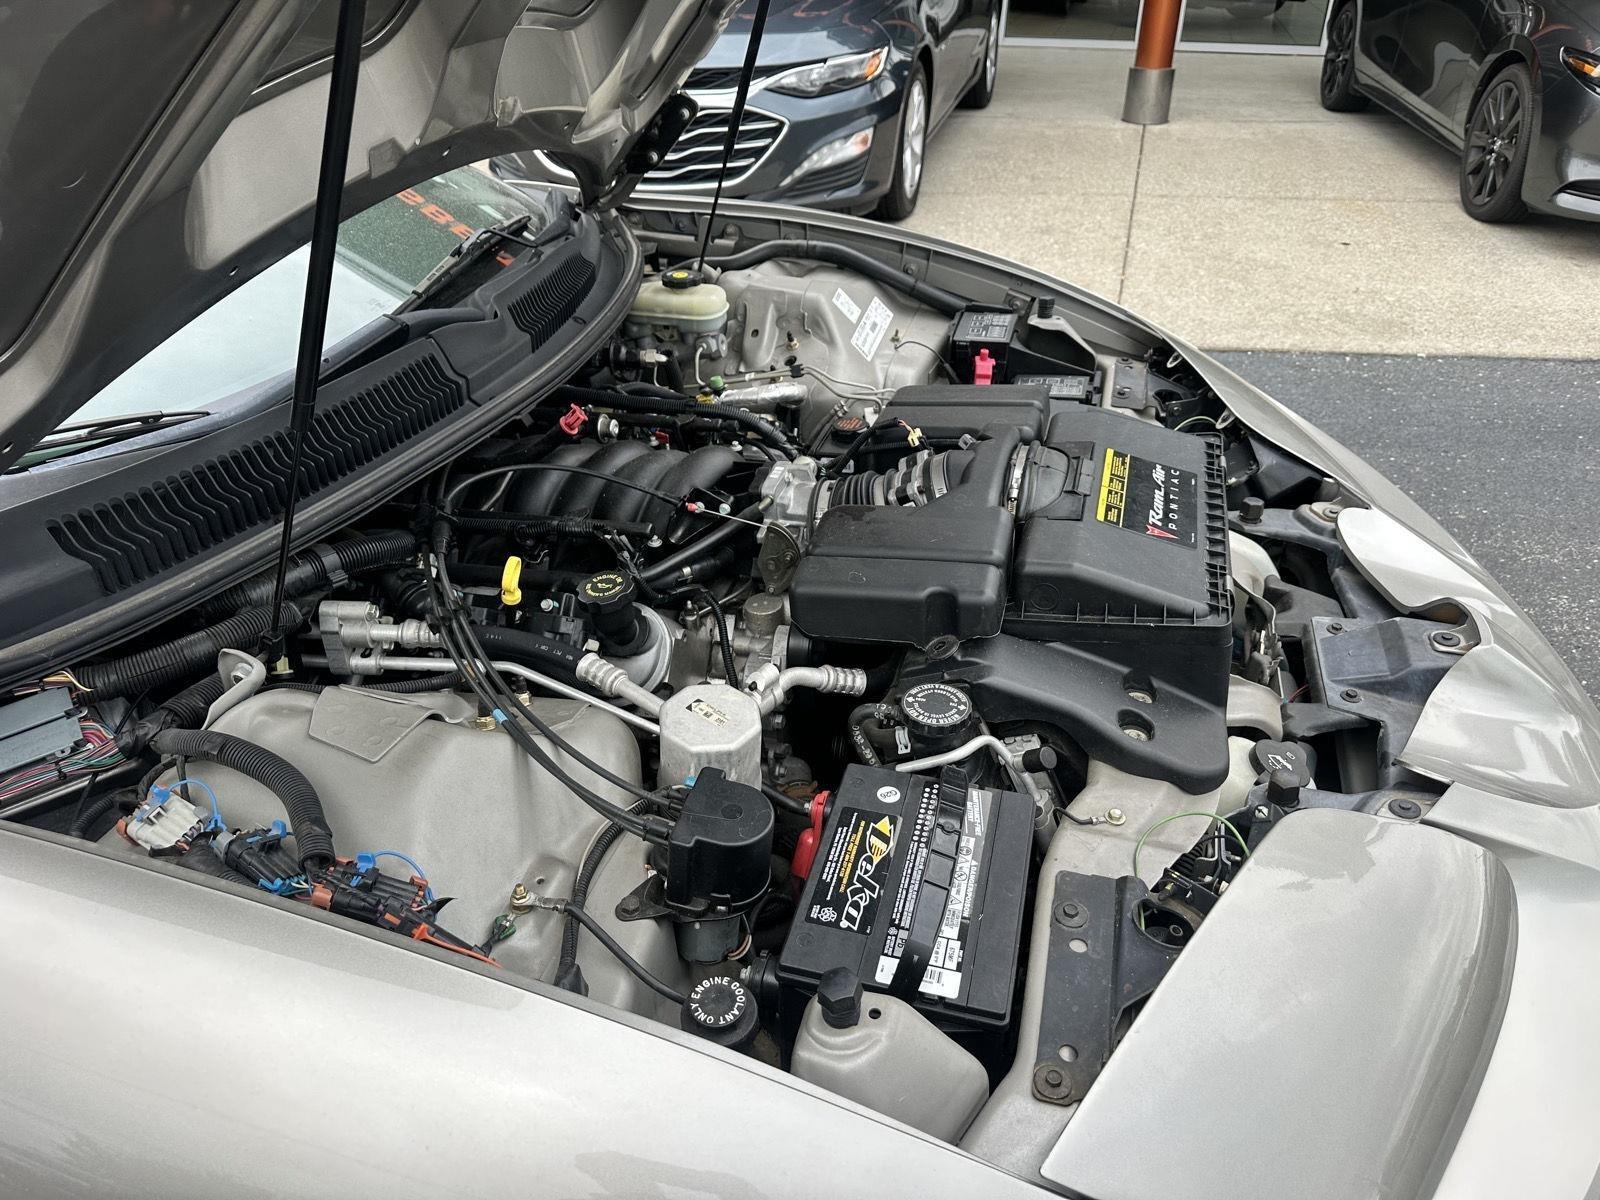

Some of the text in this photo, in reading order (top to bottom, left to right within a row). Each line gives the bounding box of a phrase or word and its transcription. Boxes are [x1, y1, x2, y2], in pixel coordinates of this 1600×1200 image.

[1149, 463, 1166, 527] Ram Air
[1168, 469, 1180, 530] PONTIAC
[592, 574, 618, 582] ENGINE
[906, 707, 918, 716] HOT
[917, 714, 936, 723] OPEN
[841, 815, 894, 931] Deka
[896, 937, 906, 949] Pb
[690, 976, 745, 1024] ENGINE COOLANT ONLY
